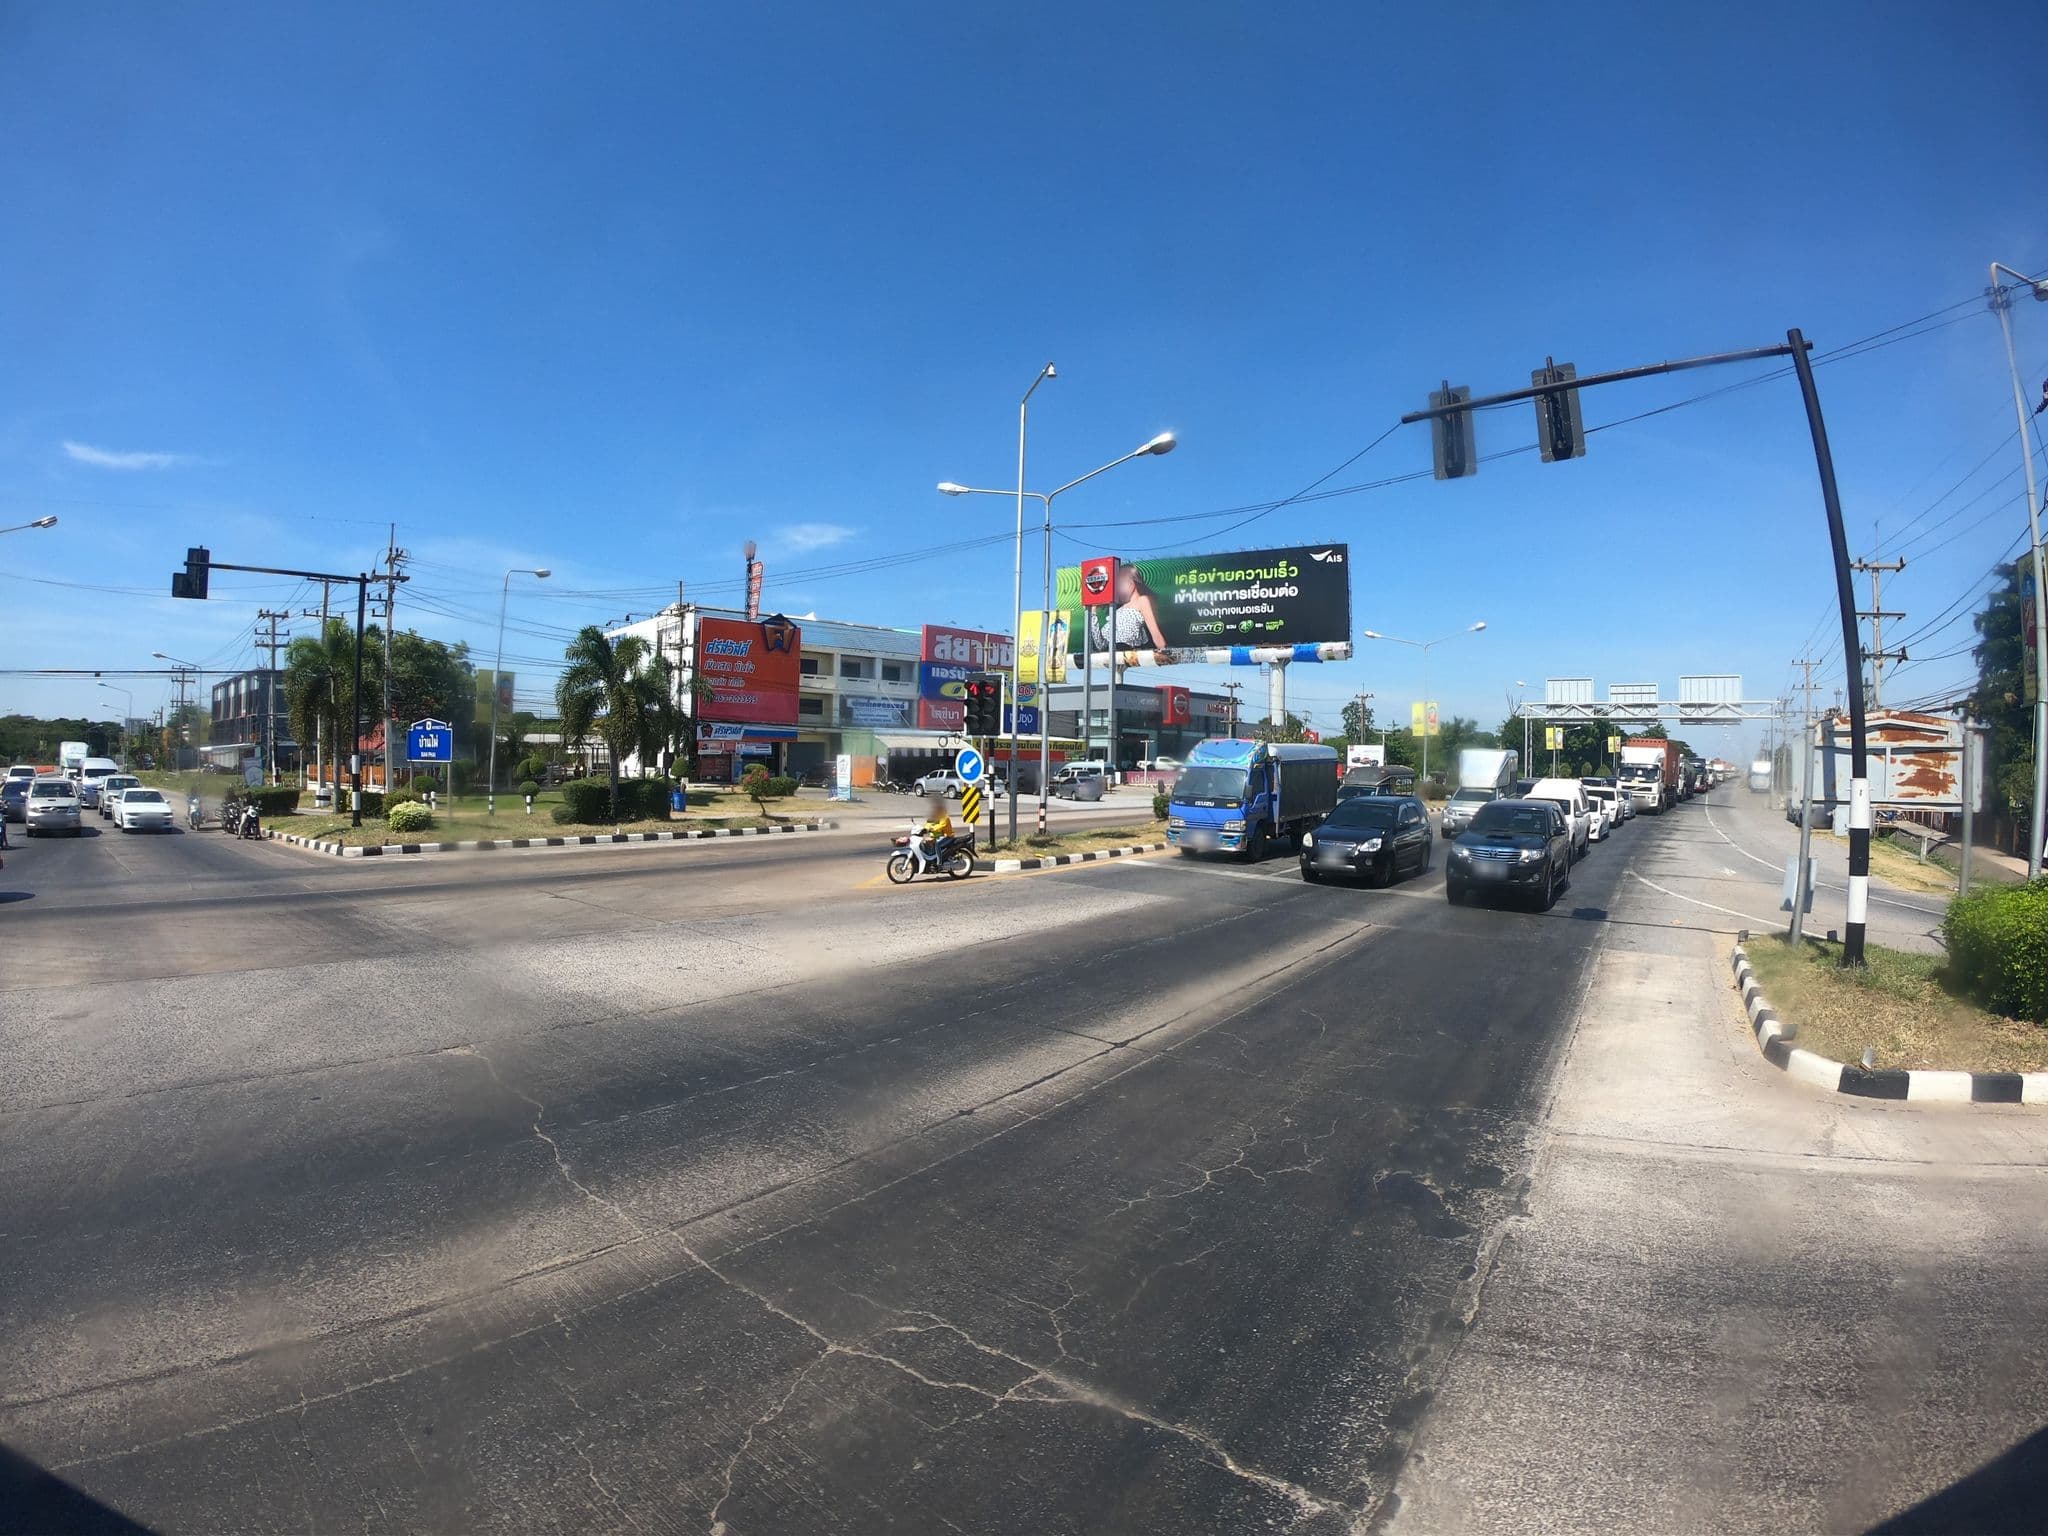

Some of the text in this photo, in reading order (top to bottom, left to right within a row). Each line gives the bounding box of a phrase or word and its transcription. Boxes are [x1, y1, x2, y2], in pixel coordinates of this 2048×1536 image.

[1326, 554, 1343, 563] AIS
[1175, 560, 1298, 585] เครือข่ายความเร็ว
[1174, 581, 1299, 605] เข้าใจทุกการเชื่อมต่อ
